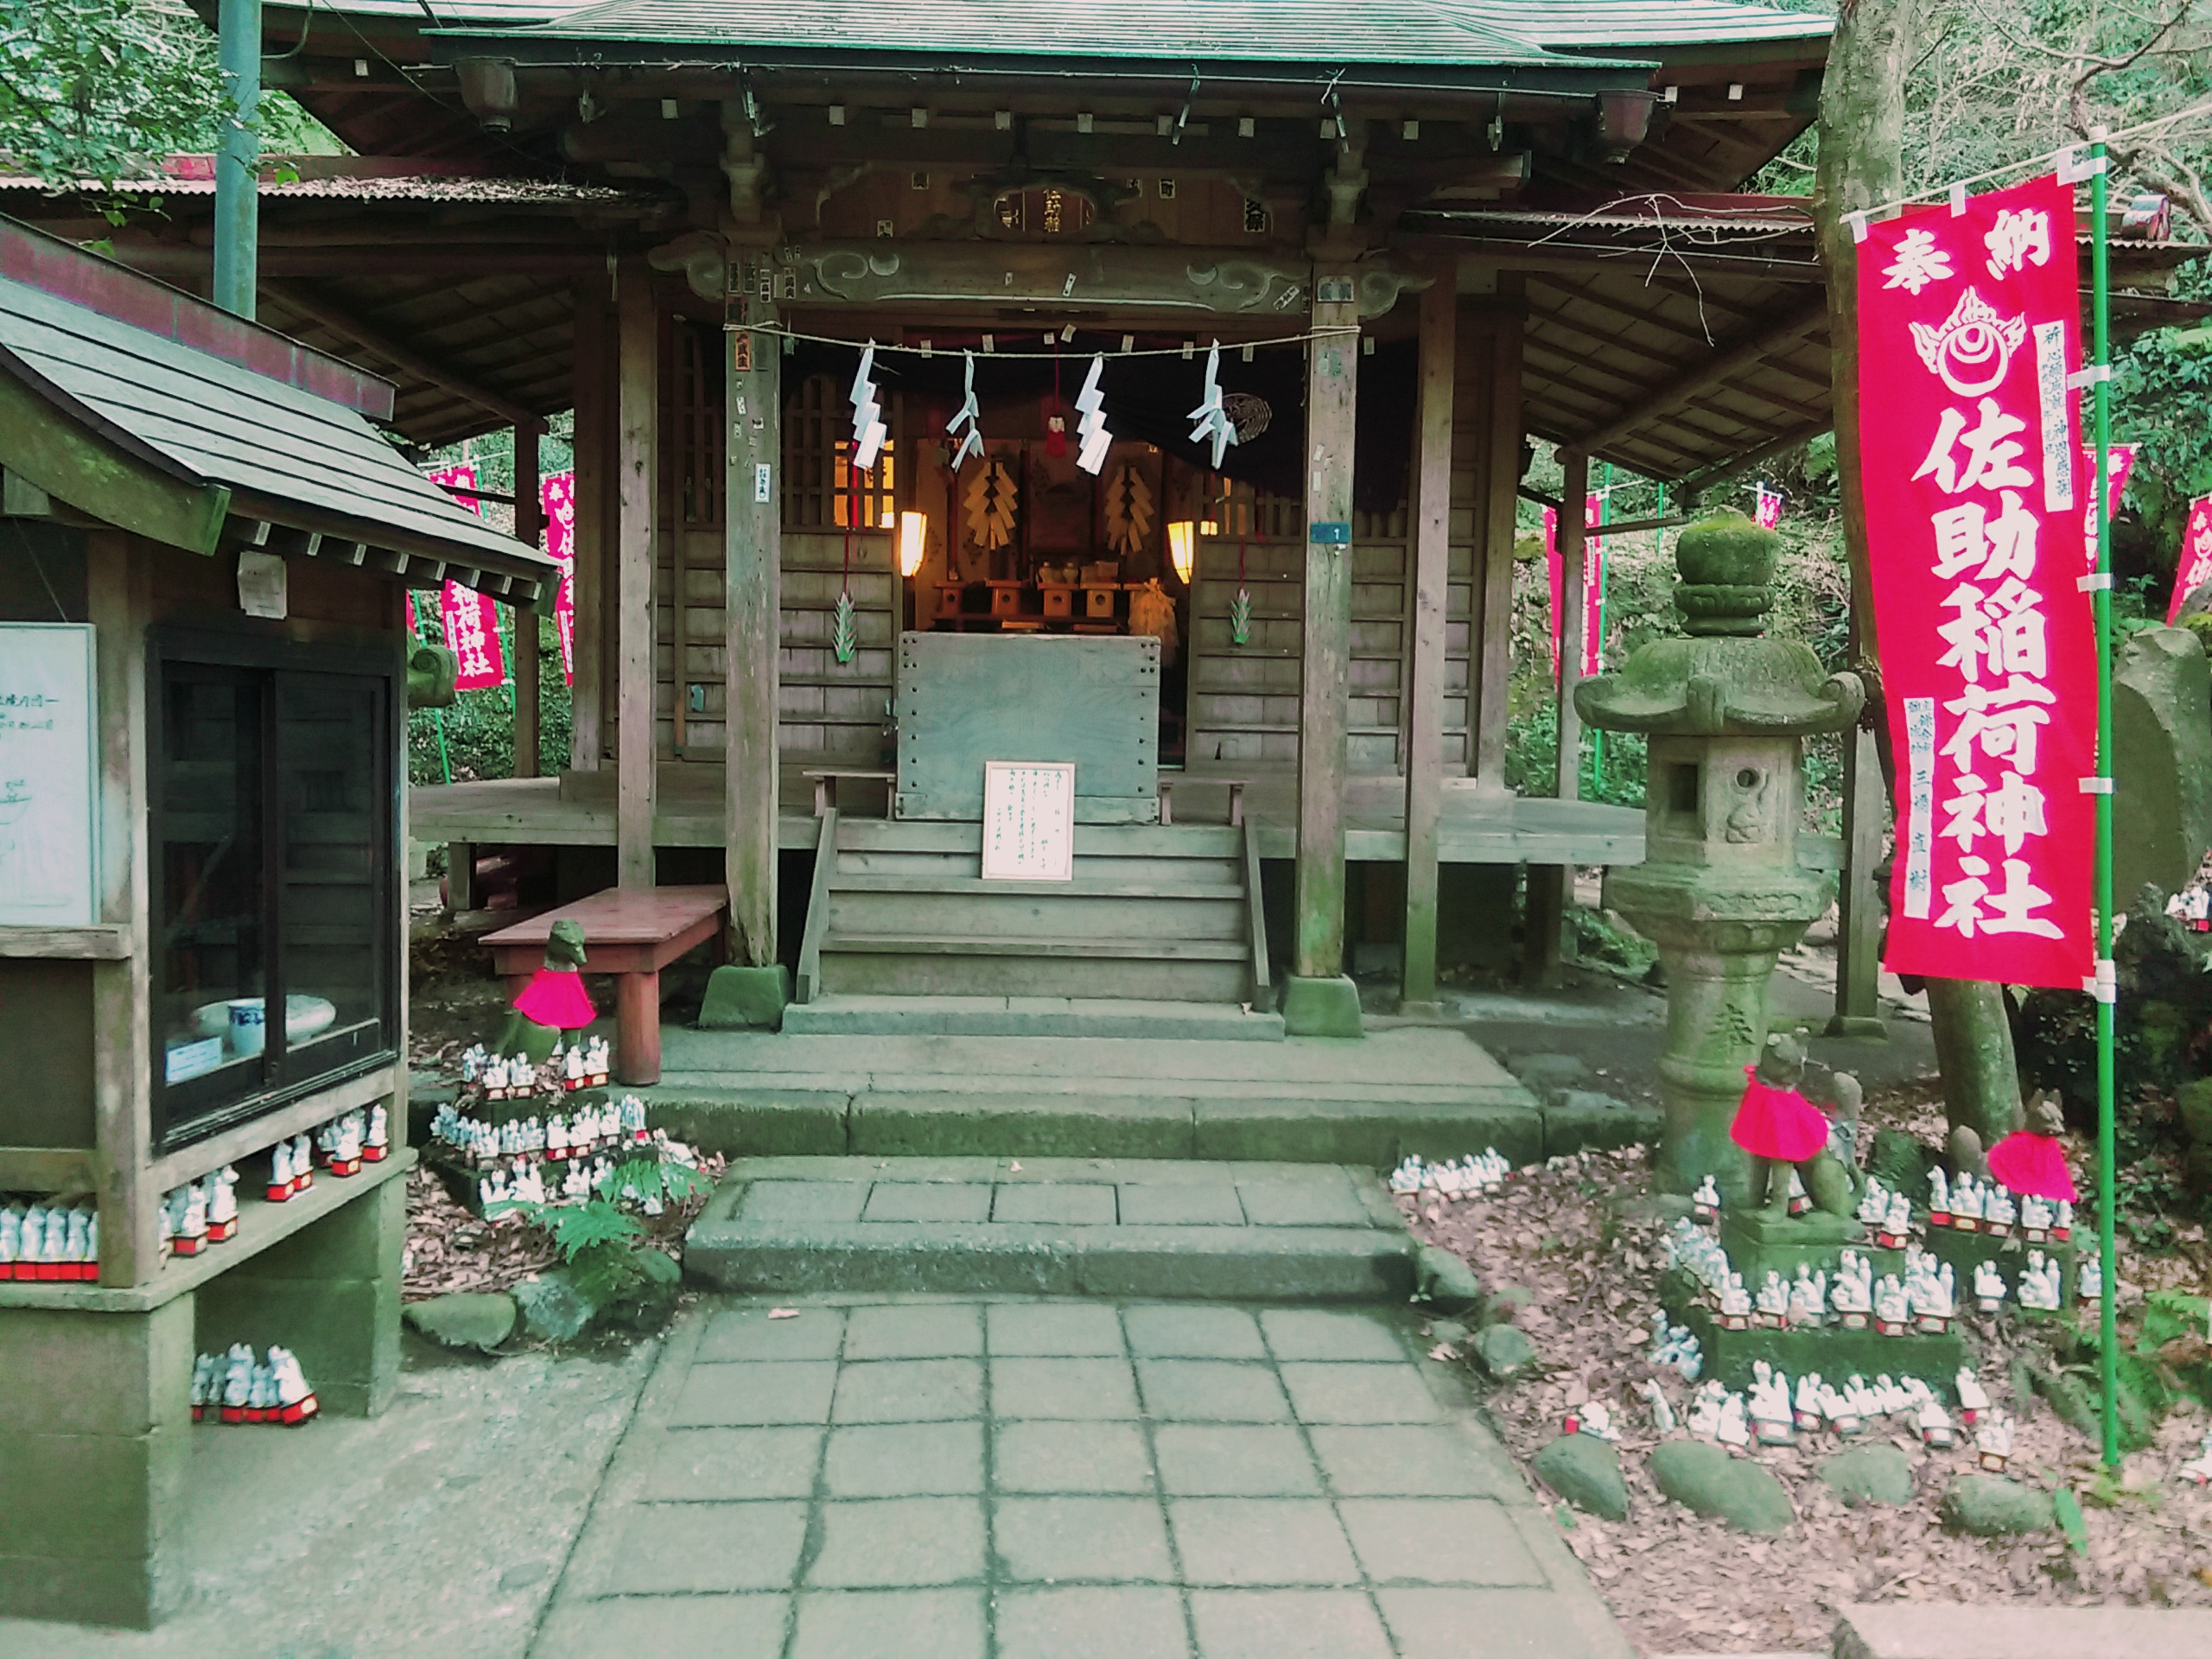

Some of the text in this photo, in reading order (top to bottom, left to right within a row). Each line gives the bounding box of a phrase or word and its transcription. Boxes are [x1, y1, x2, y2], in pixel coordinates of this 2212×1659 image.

[1882, 208, 2050, 295] 奉納
[1333, 528, 1340, 540] 1
[1910, 396, 2065, 939] 佐助稲荷神社
